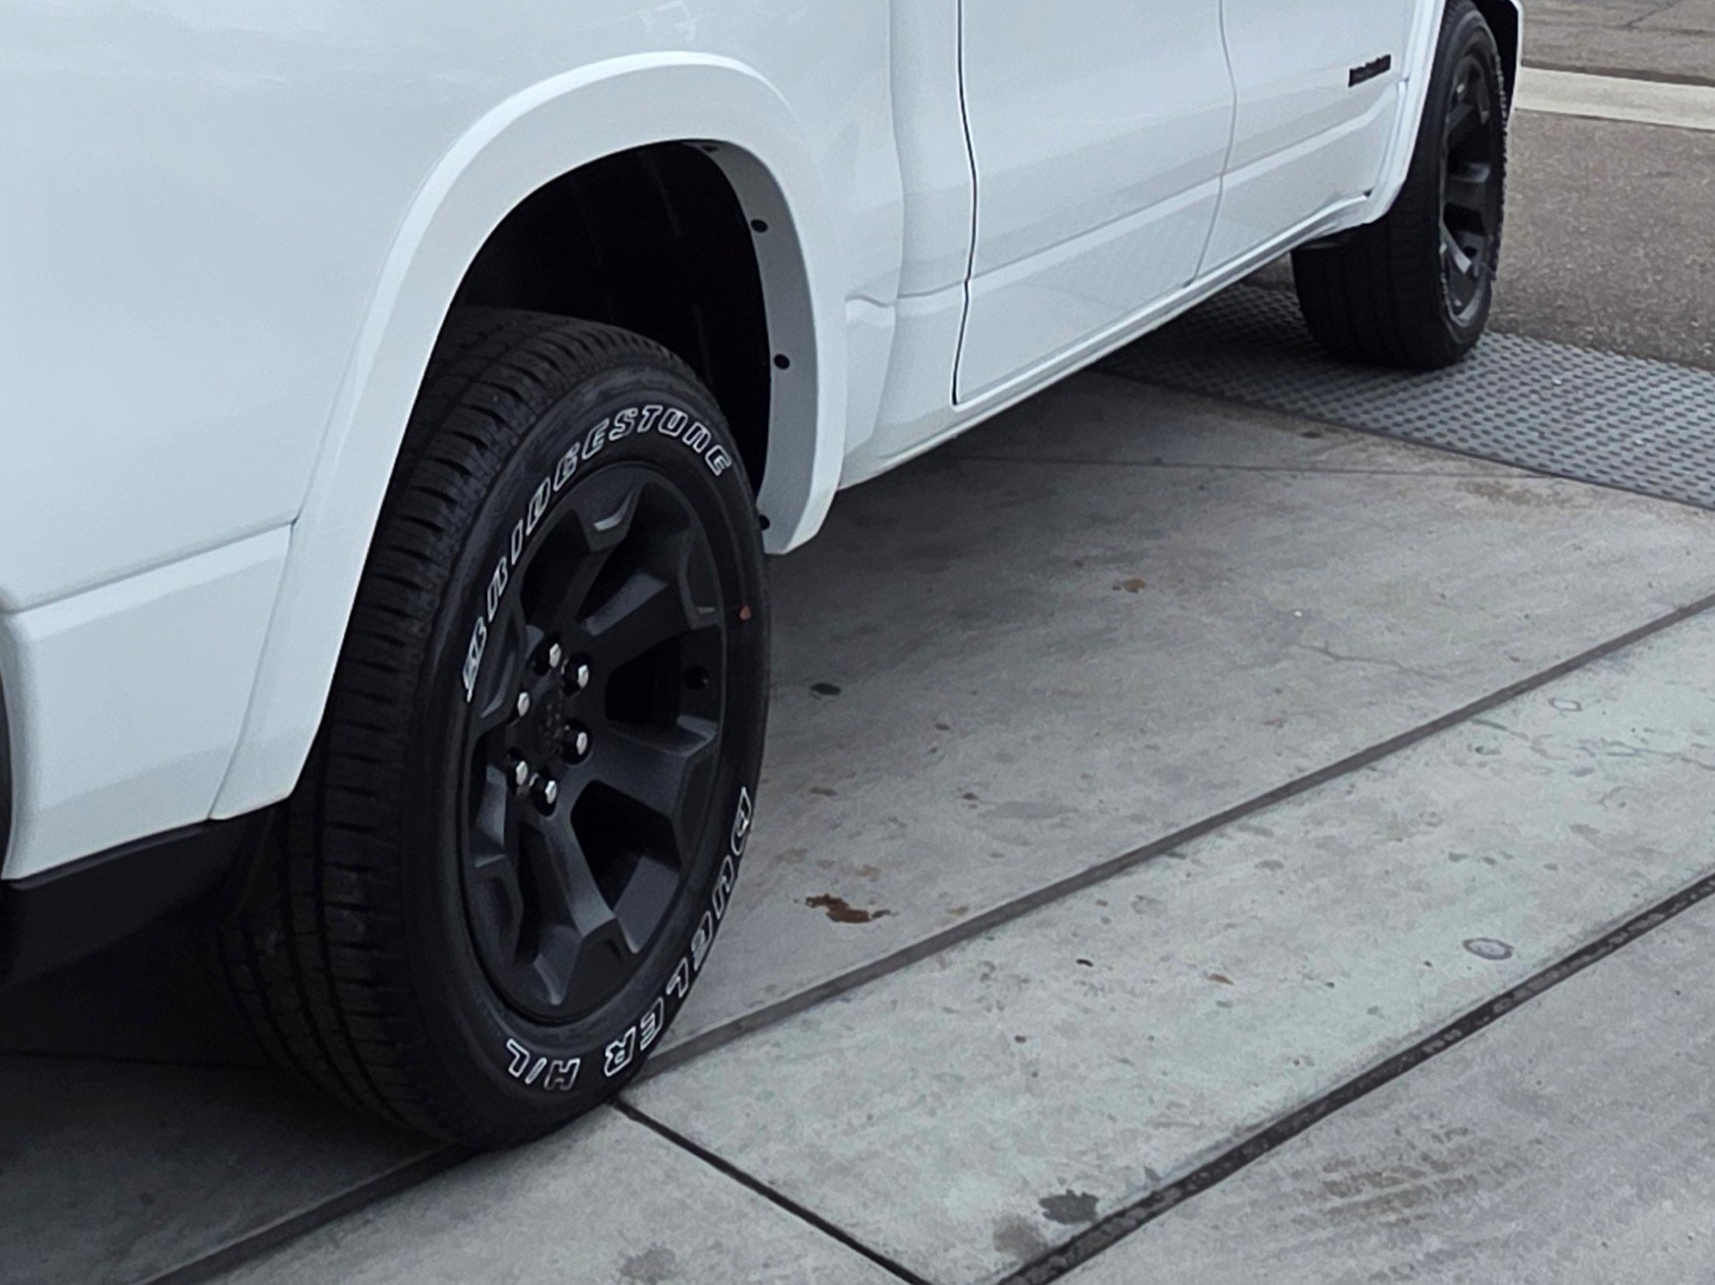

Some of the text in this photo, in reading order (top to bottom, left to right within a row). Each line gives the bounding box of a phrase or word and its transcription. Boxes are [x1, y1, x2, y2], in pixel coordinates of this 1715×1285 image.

[462, 404, 733, 704] BRIDGESTONE
[505, 786, 752, 1091] DUELER H/L
